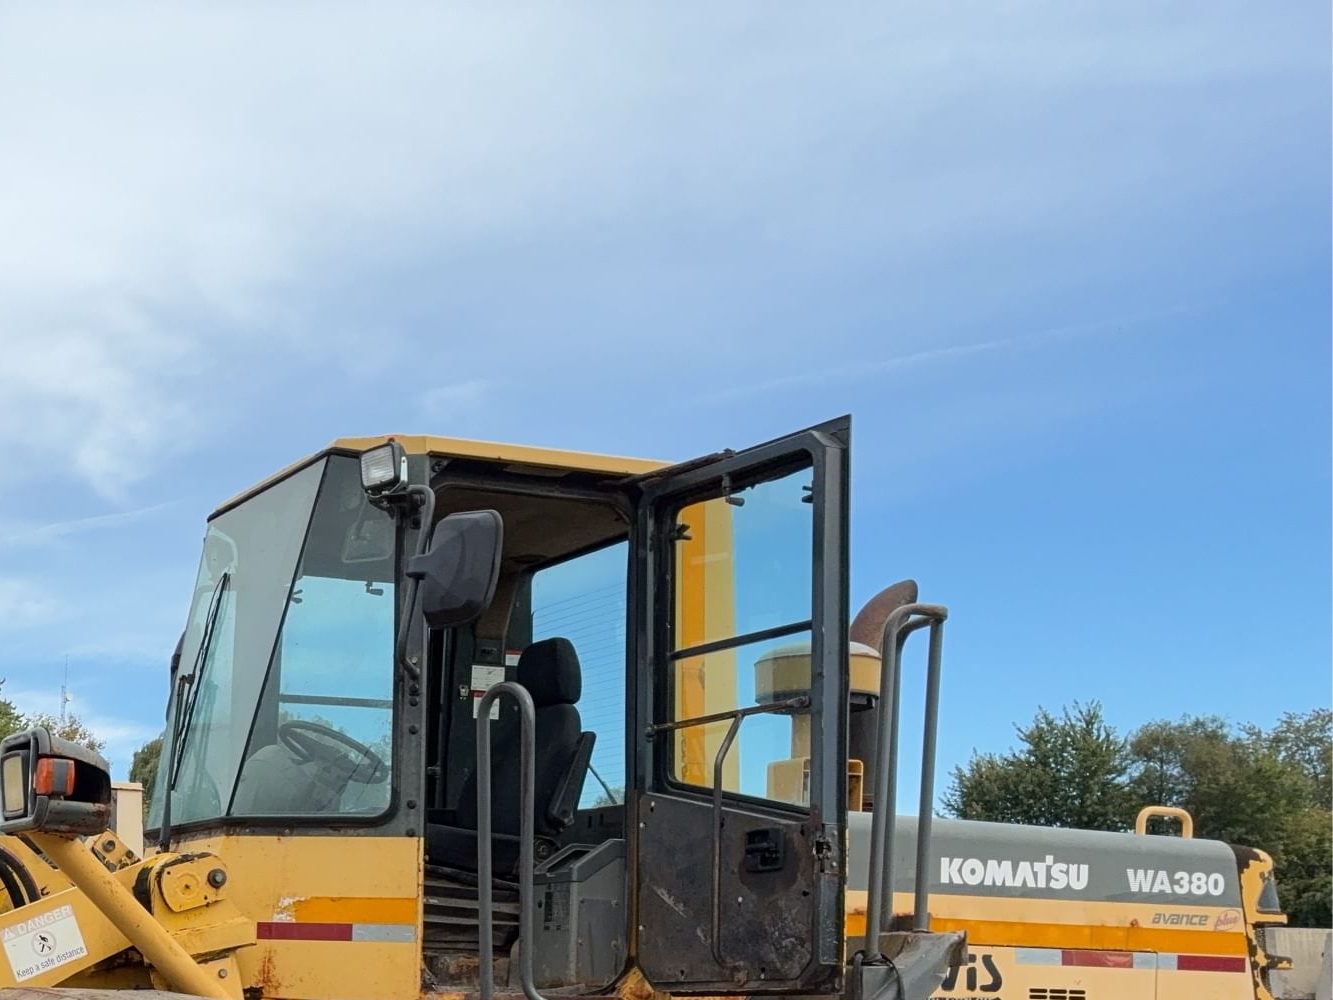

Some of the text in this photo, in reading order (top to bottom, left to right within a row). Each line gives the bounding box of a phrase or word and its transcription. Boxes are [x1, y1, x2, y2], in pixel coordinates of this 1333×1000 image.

[940, 855, 1090, 890] KOMATSU
[1126, 868, 1225, 896] WA380
[17, 905, 71, 934] DANGER
[1151, 912, 1210, 926] avance
[16, 966, 35, 978] Keep
[40, 957, 55, 969] safe
[56, 946, 84, 963] distance
